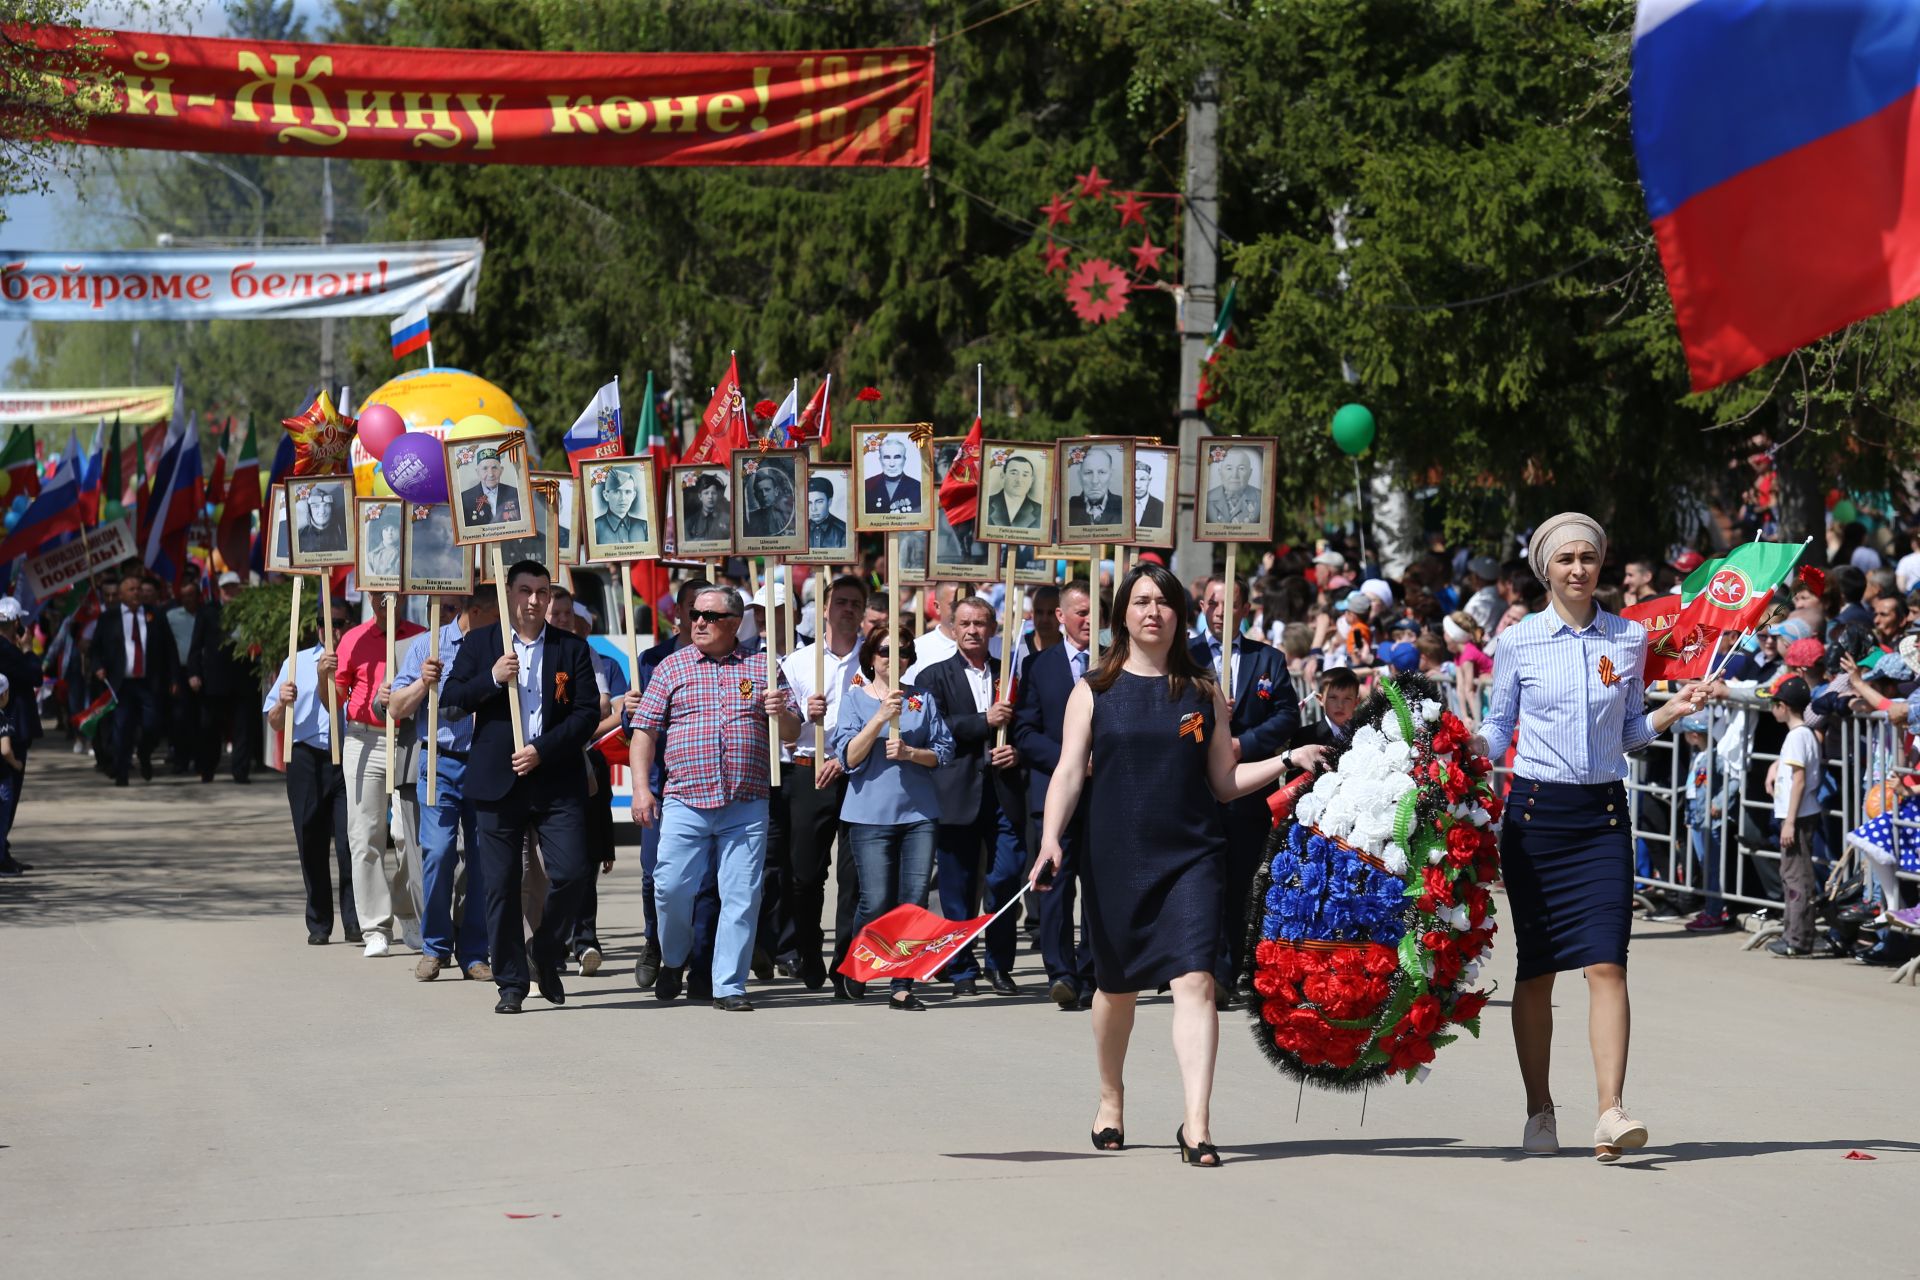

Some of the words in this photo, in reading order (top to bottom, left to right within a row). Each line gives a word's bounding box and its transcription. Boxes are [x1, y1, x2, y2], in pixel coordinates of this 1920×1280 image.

[547, 67, 771, 133] көне!
[1, 261, 212, 308] бәйрәме
[230, 261, 389, 298] белән!
[34, 560, 44, 576] С
[41, 539, 125, 589] ПОБЕДЫ!
